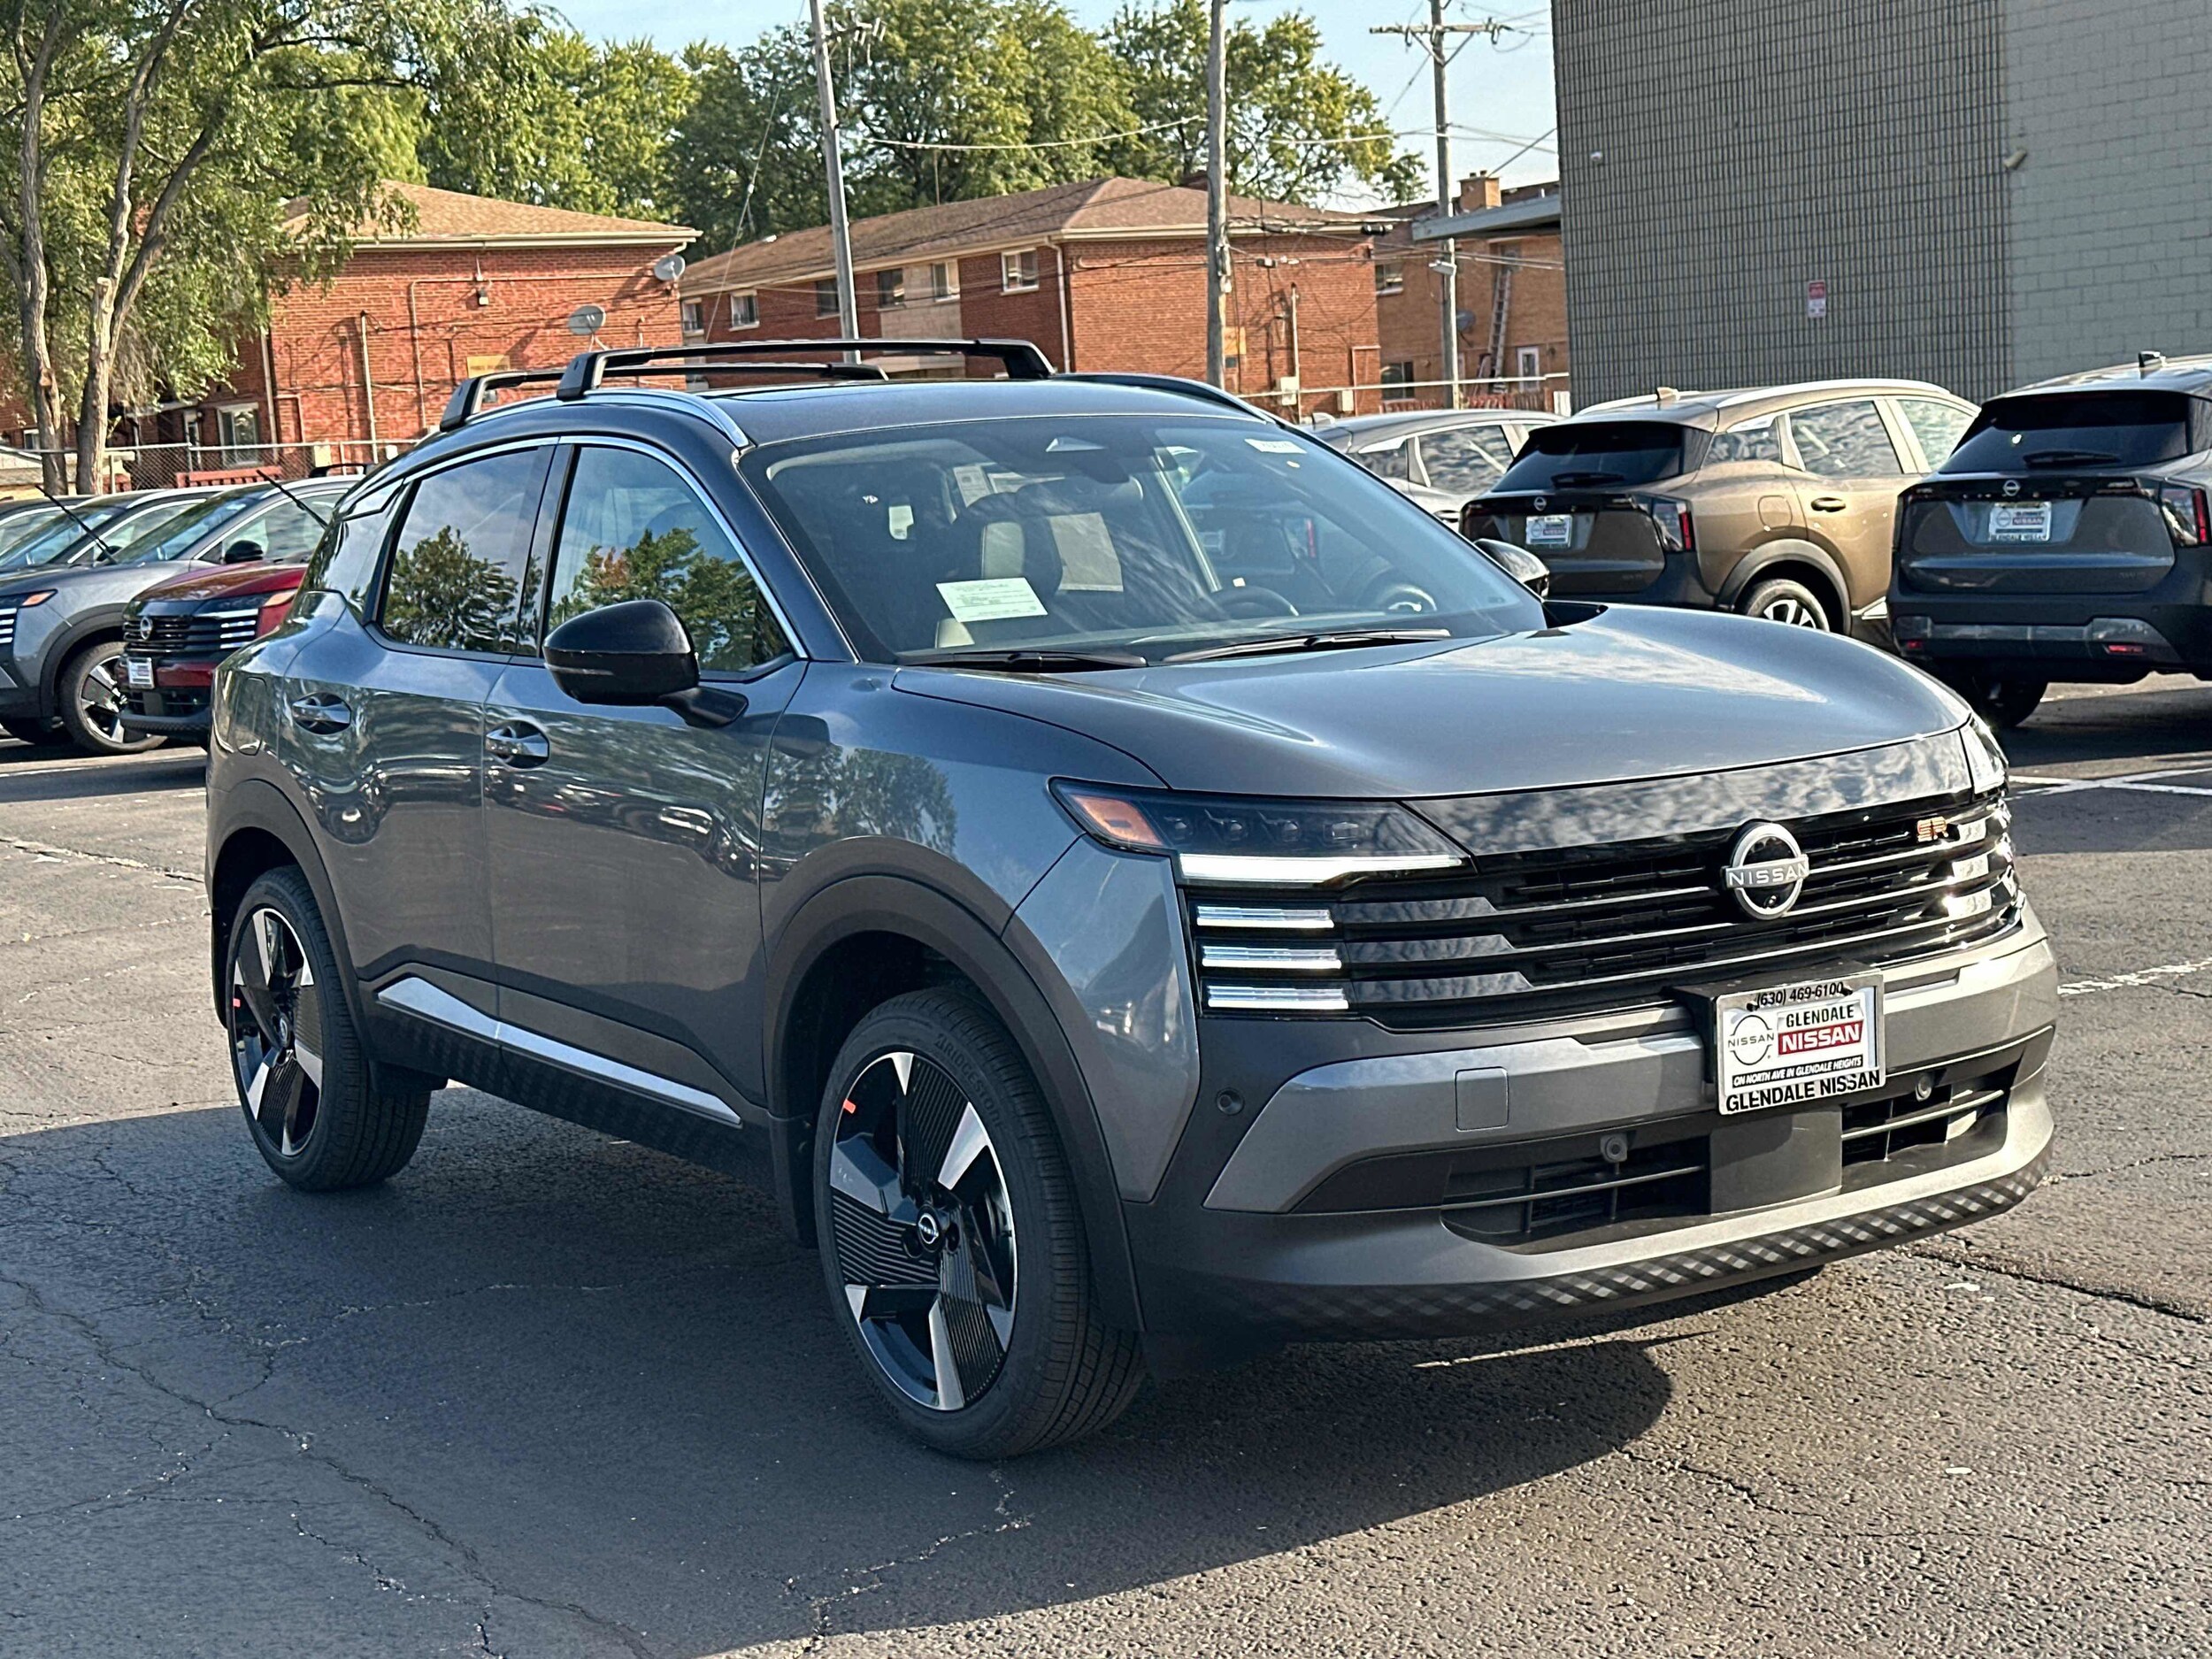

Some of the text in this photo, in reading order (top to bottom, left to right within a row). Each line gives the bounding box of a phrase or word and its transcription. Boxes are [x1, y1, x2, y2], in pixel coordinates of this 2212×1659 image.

[1728, 862, 1809, 886] NISSAN
[1757, 982, 1843, 1008] (630) 469-6100
[1786, 1004, 1854, 1028] GLENDALE
[1728, 1033, 1774, 1048] NISSAN
[1782, 1025, 1859, 1053] NISSAN
[1734, 1056, 1862, 1086] ON NORTH AVE IN GLENDALE HEIGHTS
[1726, 1071, 1880, 1111] GLENDALE NISSAN
